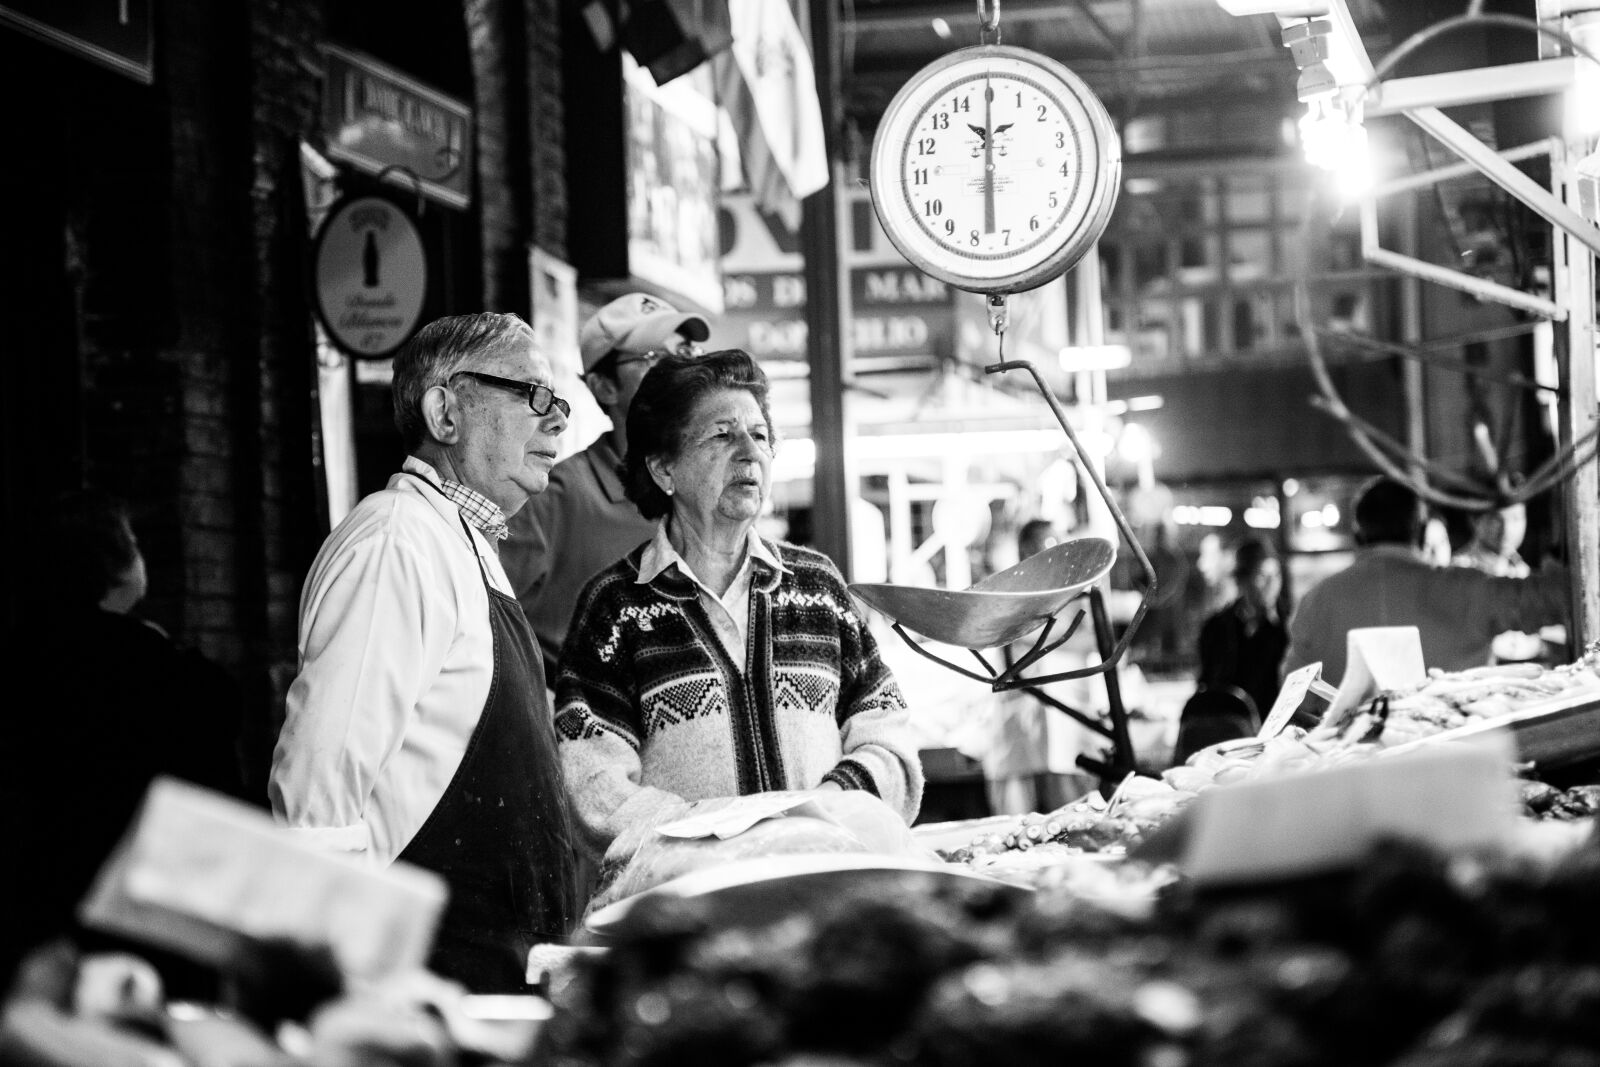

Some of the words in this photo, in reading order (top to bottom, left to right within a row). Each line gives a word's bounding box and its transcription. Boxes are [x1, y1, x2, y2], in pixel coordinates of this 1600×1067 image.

[952, 95, 970, 113] 14
[1015, 91, 1022, 108] 1
[932, 112, 949, 130] 13
[1037, 105, 1047, 122] 2
[918, 138, 936, 155] 12
[1055, 131, 1065, 149] 3
[913, 168, 928, 185] 11
[1059, 160, 1069, 177] 4
[925, 198, 942, 216] 10
[1048, 191, 1058, 208] 5
[945, 218, 955, 236] 9
[1029, 214, 1040, 232] 6
[970, 230, 980, 247] 8
[1001, 229, 1011, 246] 7
